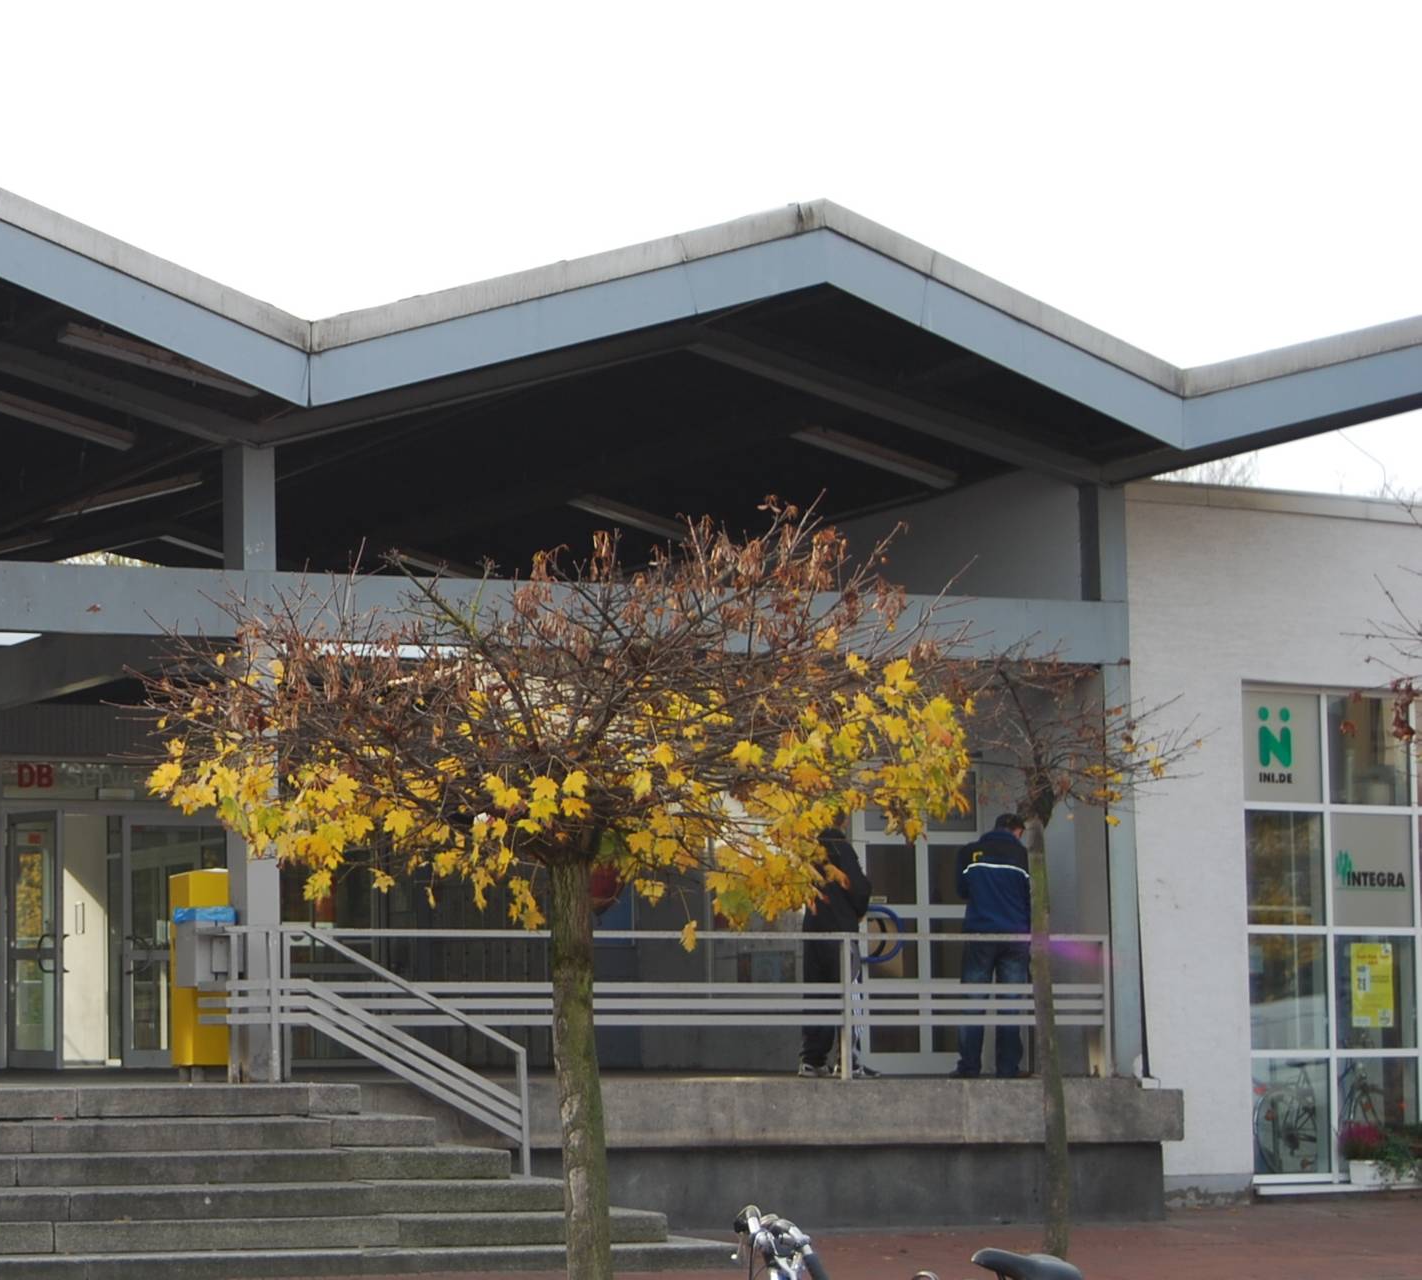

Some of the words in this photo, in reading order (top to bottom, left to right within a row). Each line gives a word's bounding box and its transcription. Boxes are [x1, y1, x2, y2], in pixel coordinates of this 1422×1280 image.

[17, 764, 53, 788] DB
[1259, 772, 1293, 784] INI.DE
[1347, 871, 1406, 888] INTEGRA
